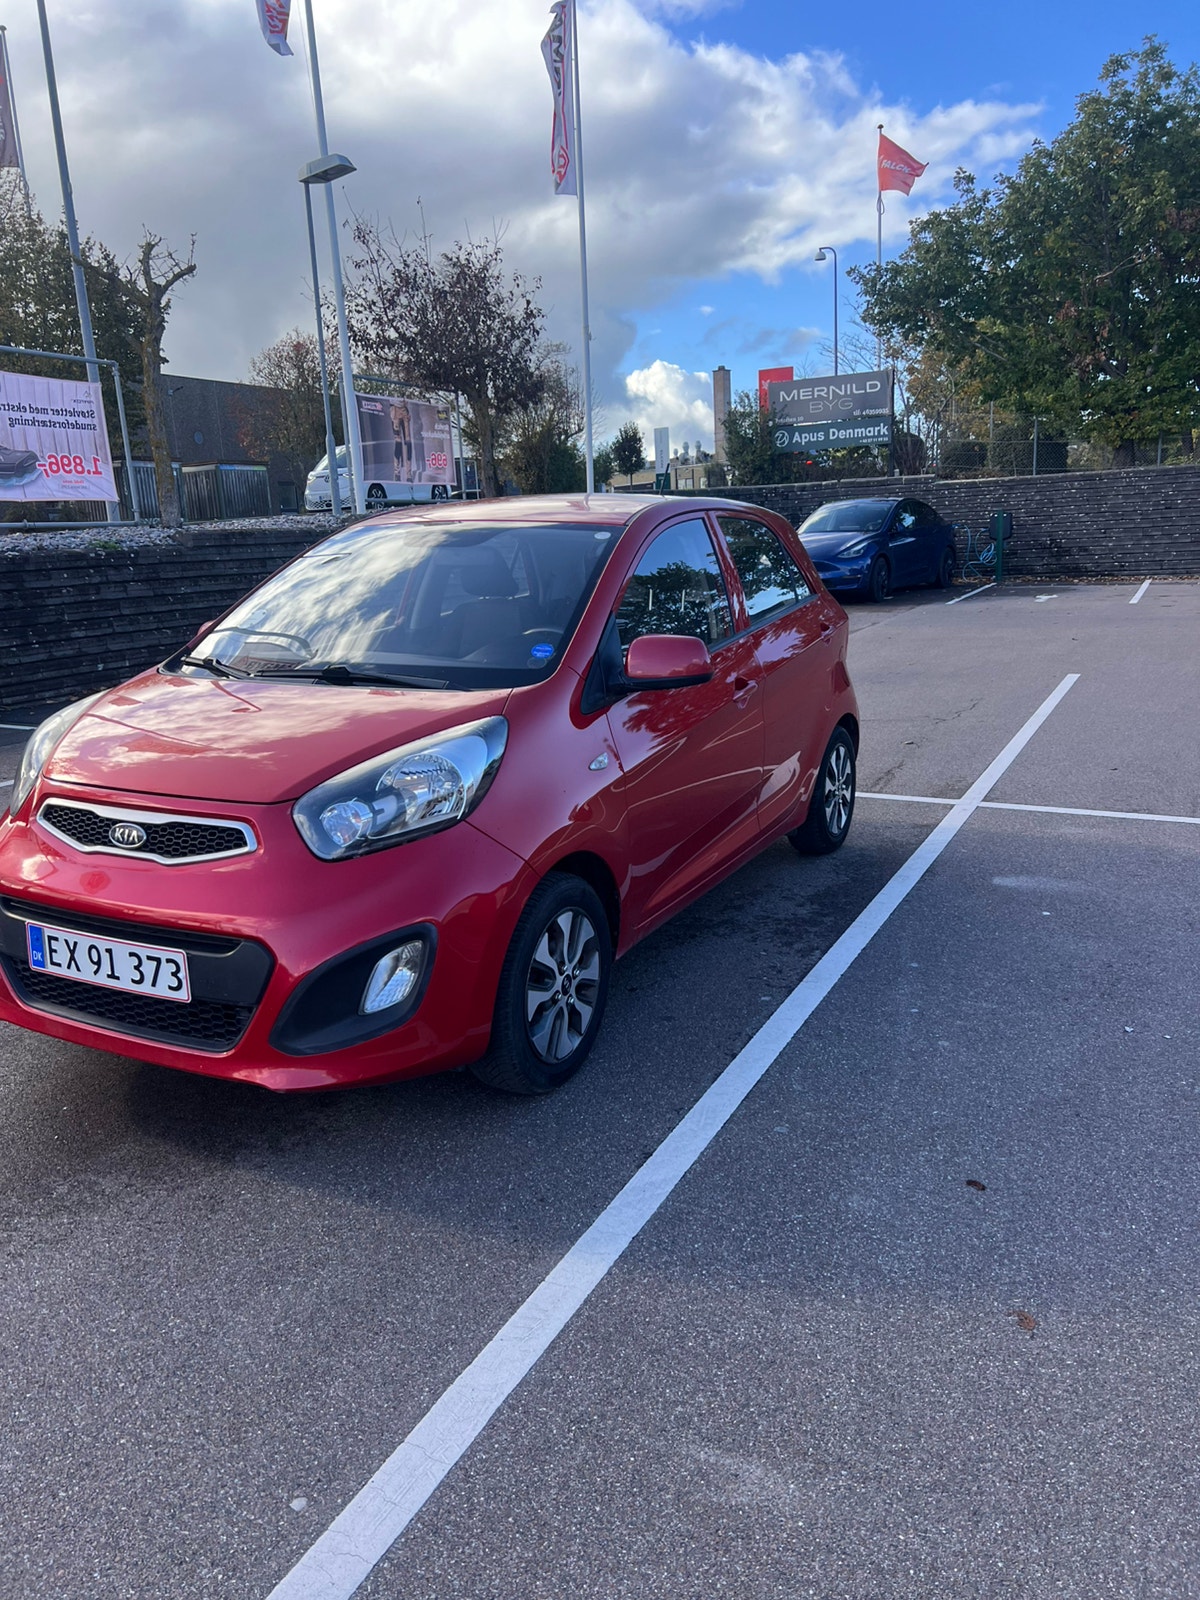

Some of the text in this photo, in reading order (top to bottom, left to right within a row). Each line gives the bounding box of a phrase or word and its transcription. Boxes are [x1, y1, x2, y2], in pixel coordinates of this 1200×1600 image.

[780, 381, 881, 402] MERNILD
[809, 397, 853, 414] BYG
[792, 423, 889, 445] Apus Denmark
[114, 828, 139, 843] KIA
[33, 950, 43, 962] DK
[47, 935, 184, 992] EX 91 373
